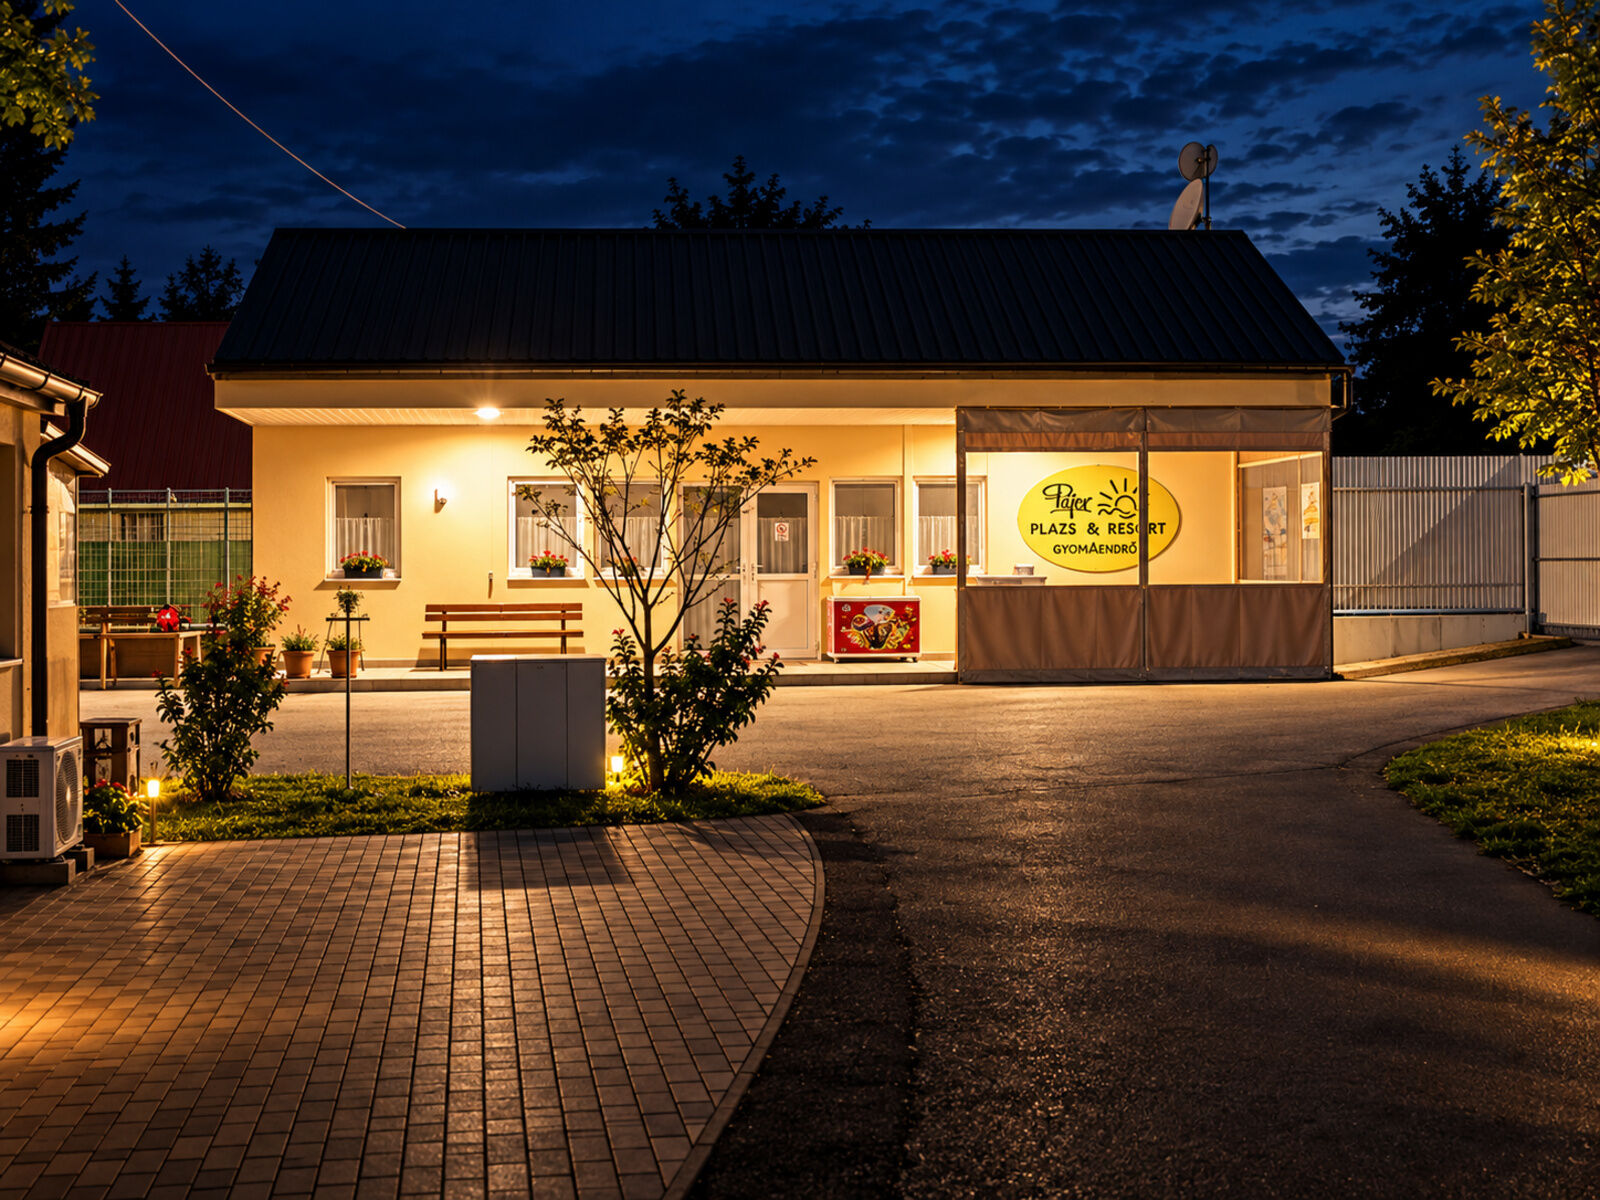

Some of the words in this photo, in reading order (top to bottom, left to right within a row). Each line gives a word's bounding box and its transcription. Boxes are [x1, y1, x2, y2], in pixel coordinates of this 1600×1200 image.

[1030, 522, 1077, 535] PLAZS
[1087, 522, 1100, 536] &
[1108, 522, 1166, 535] RESRT
